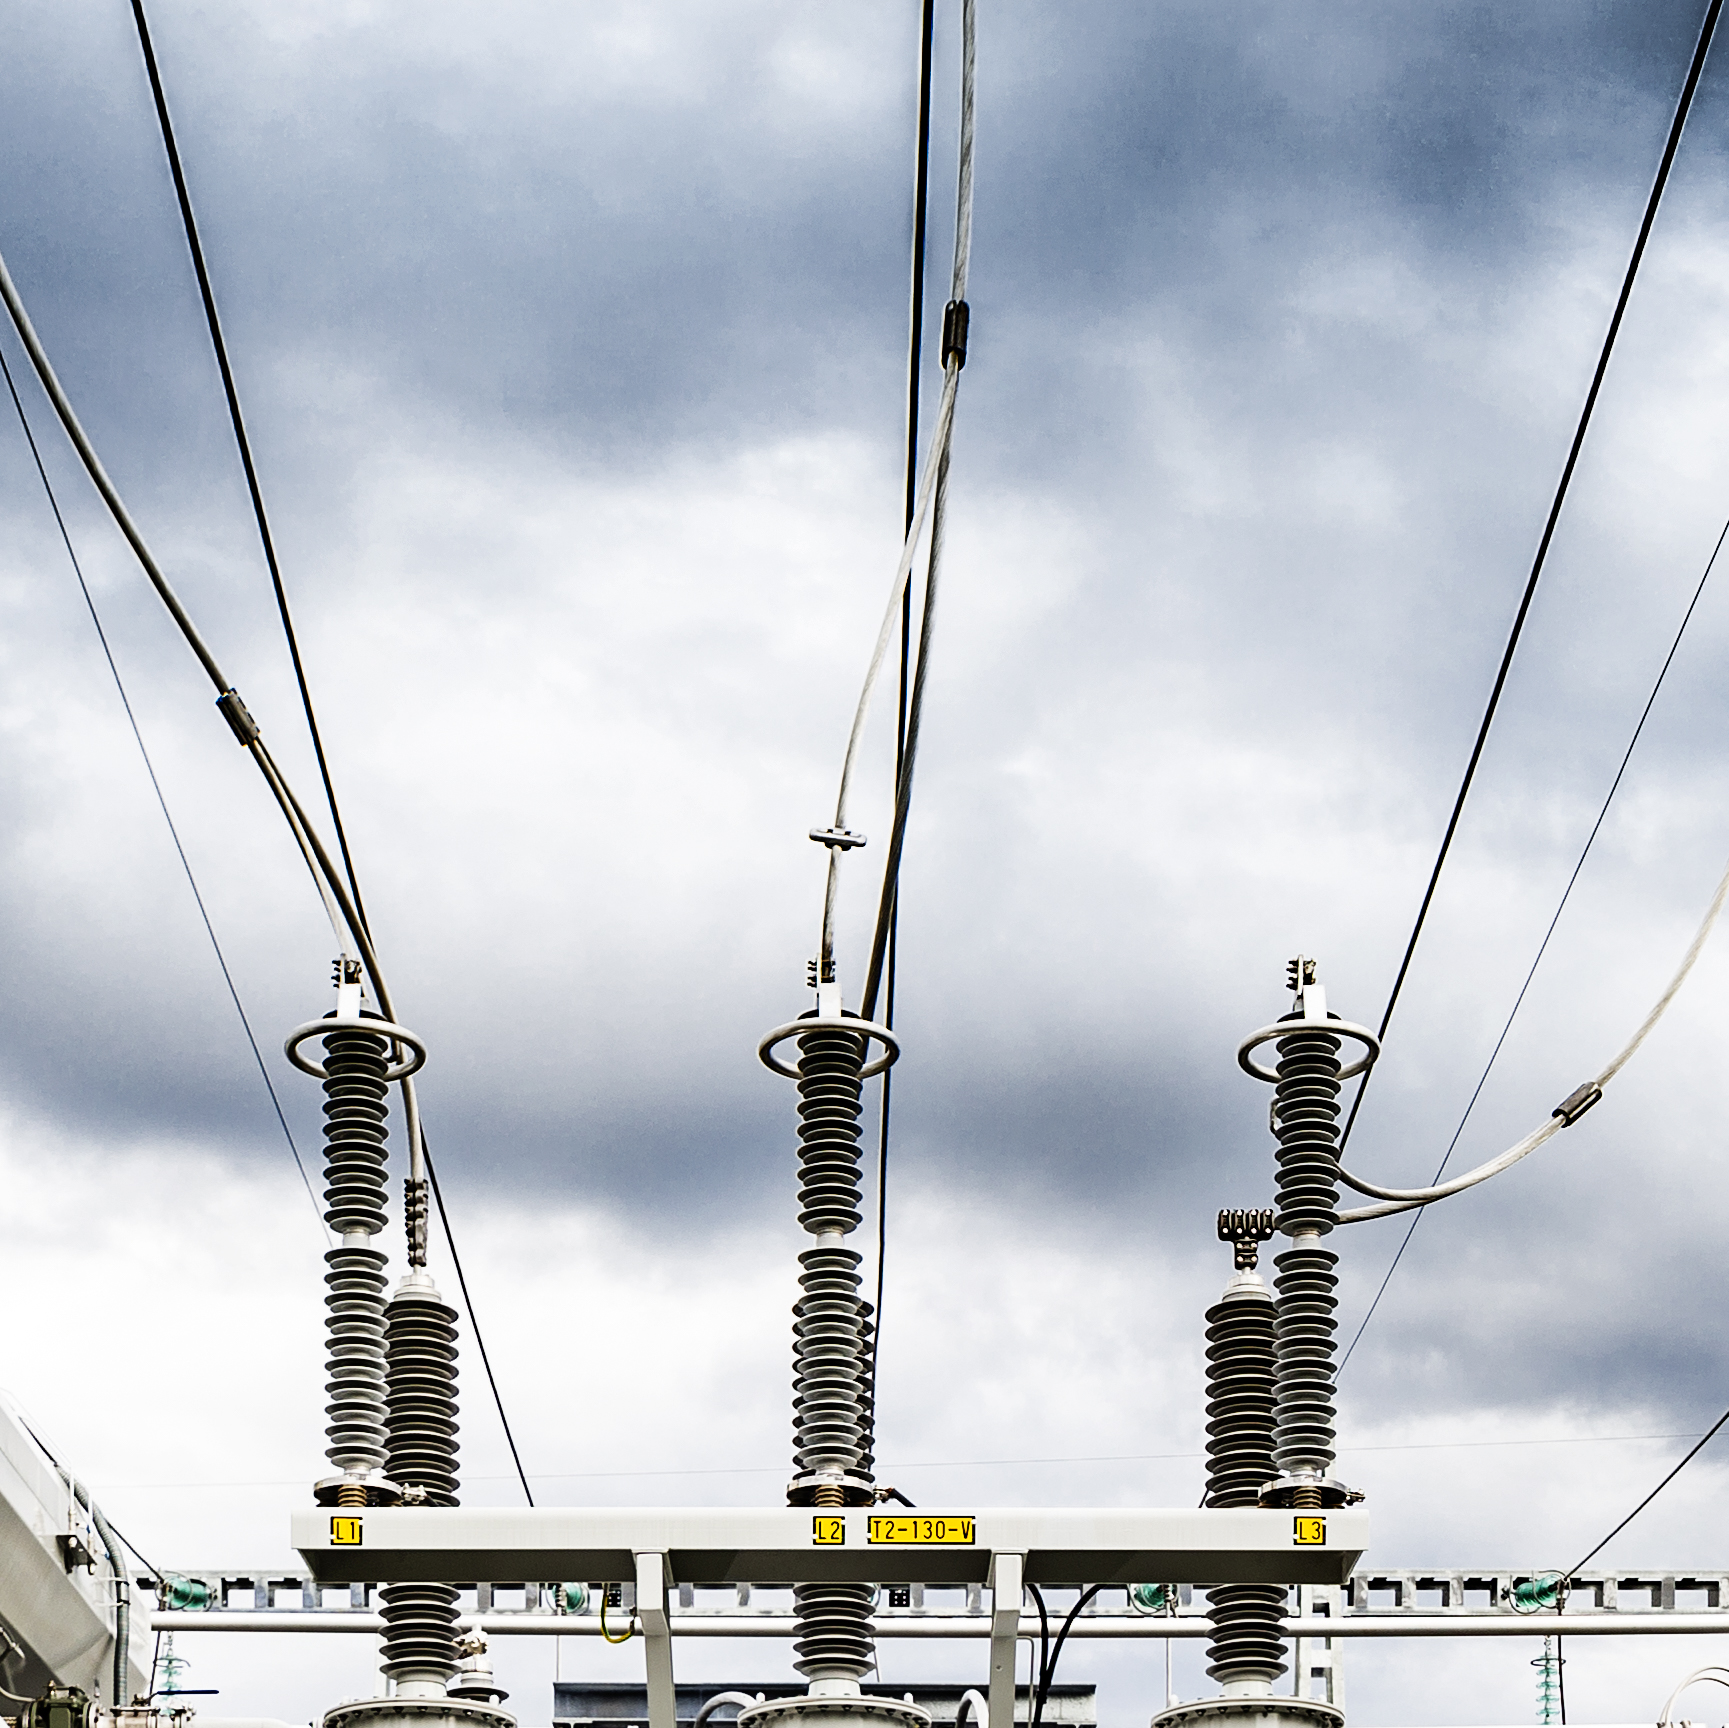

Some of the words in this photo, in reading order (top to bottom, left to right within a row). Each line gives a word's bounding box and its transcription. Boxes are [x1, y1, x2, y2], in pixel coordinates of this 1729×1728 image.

[336, 1521, 355, 1540] L1
[818, 1521, 840, 1540] L2
[873, 1521, 970, 1539] T2-130-V
[1299, 1521, 1321, 1540] L3
